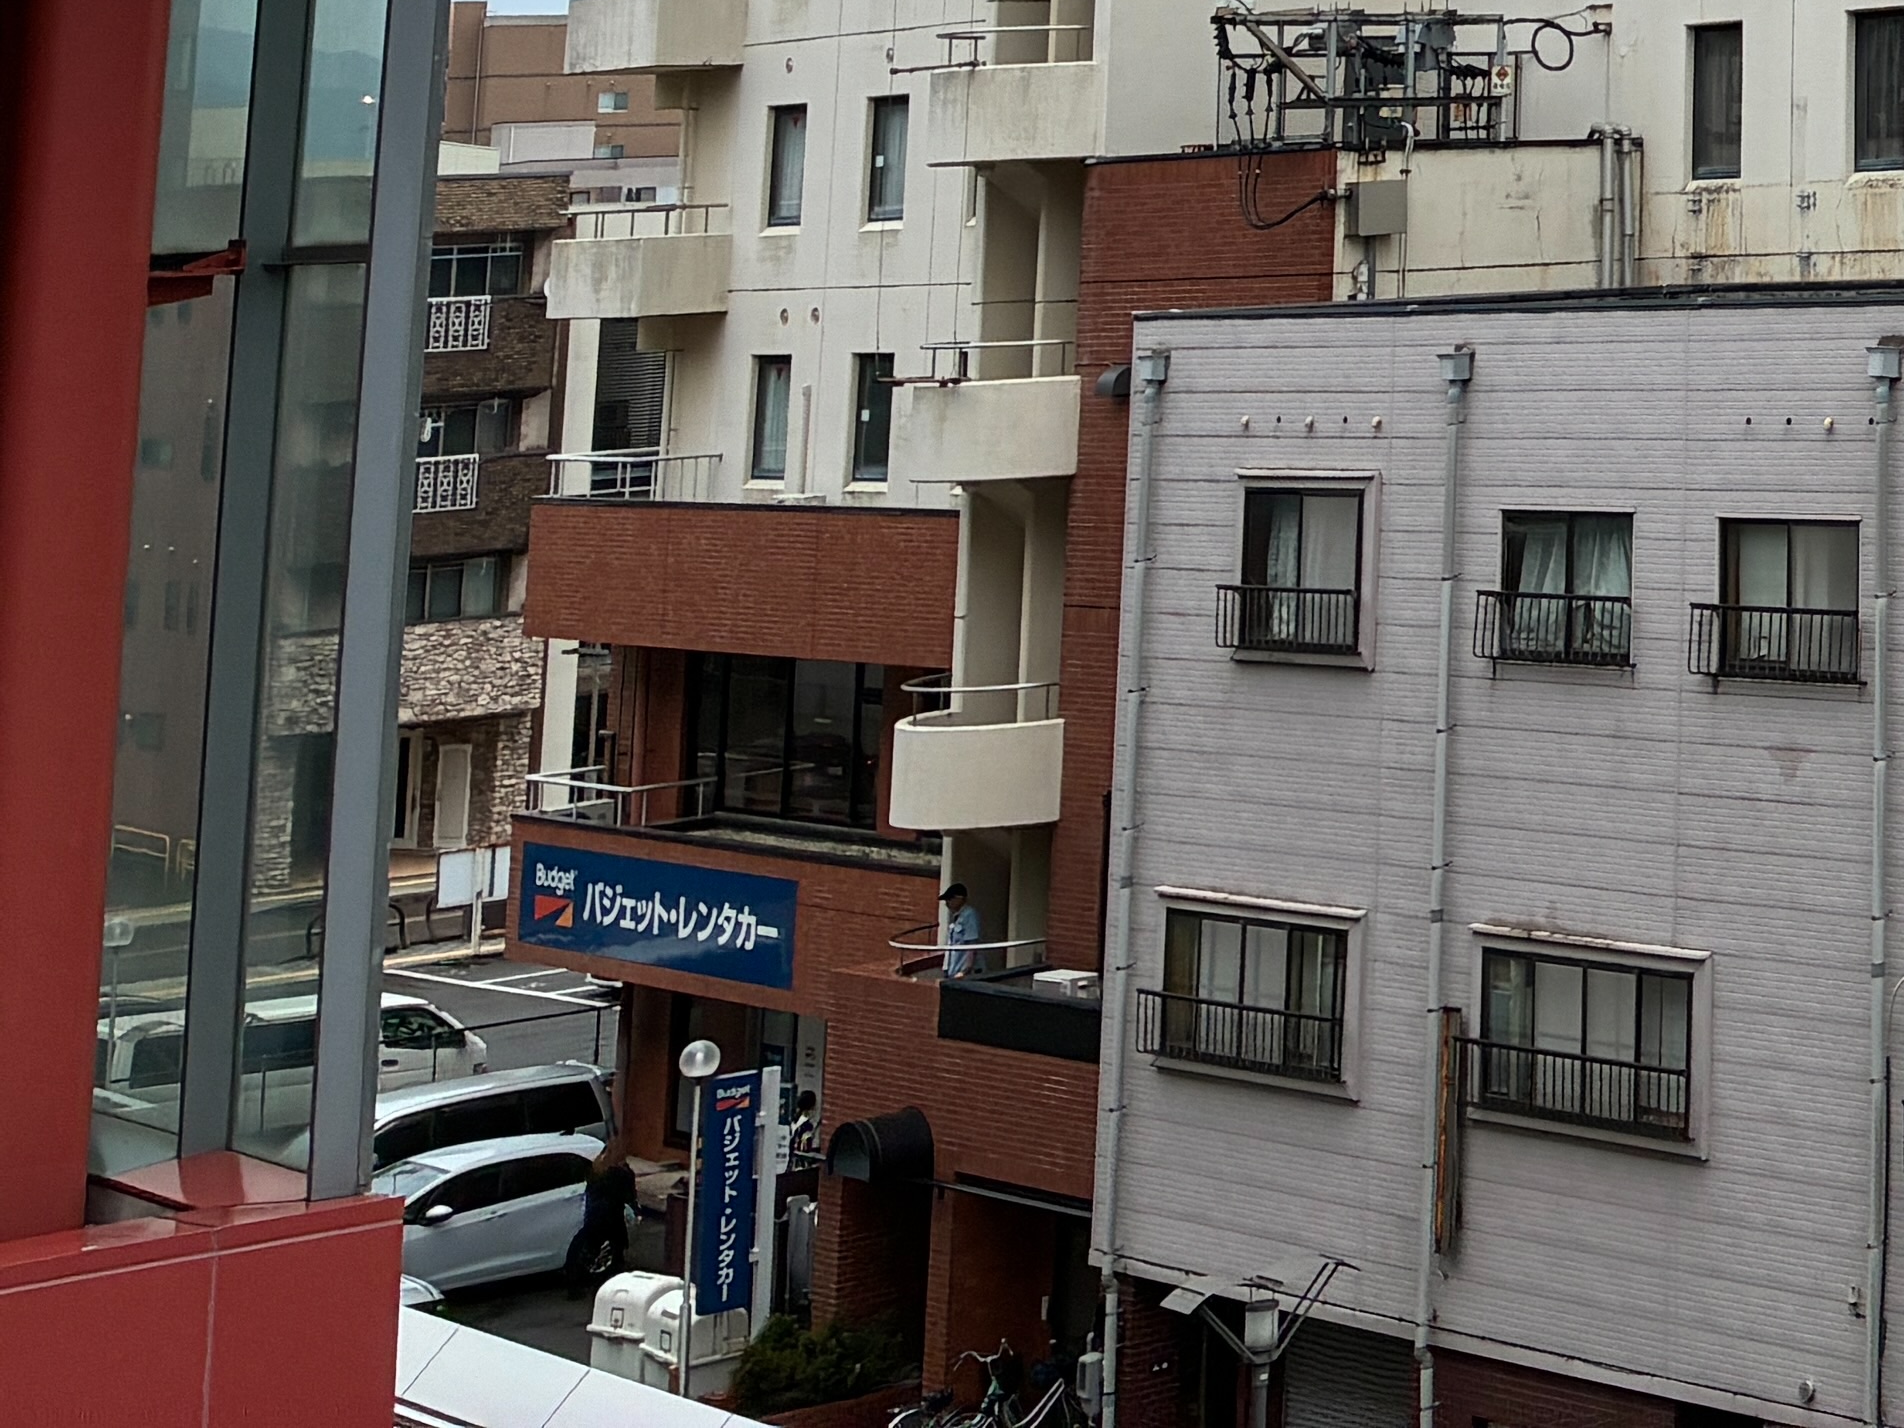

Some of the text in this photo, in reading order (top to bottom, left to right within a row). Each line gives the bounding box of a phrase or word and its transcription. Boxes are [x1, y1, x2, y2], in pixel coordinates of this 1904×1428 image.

[536, 862, 577, 895] Budget
[582, 882, 779, 951] バジェット・レンタカー
